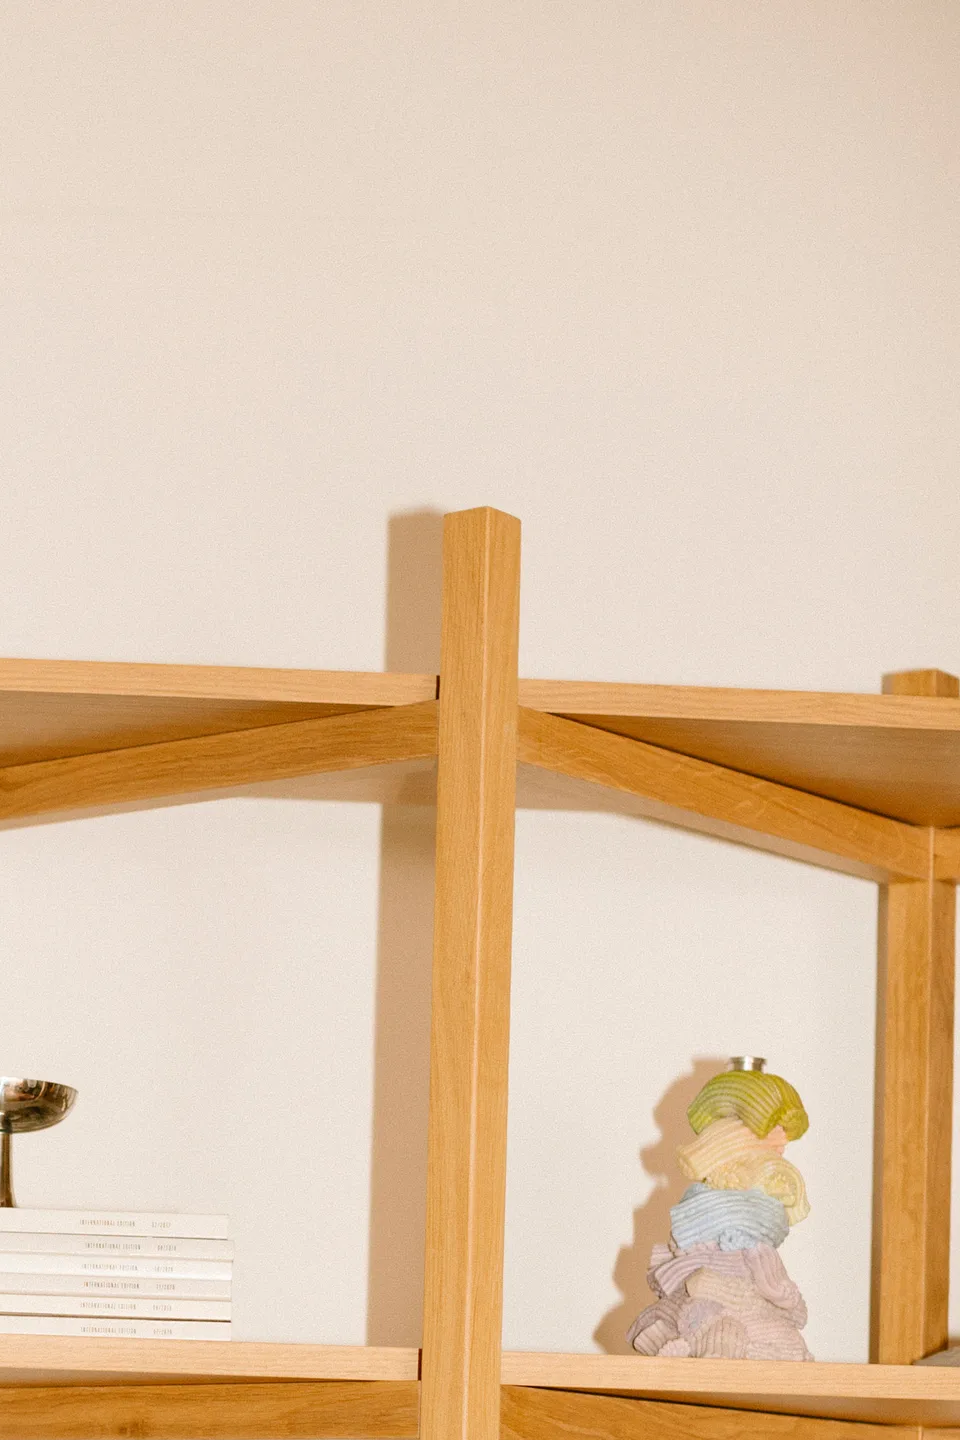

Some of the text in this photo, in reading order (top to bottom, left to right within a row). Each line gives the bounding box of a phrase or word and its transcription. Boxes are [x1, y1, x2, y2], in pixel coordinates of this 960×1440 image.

[79, 1219, 115, 1227] INTERNATIONAL
[116, 1220, 136, 1228] EDITION
[85, 1242, 121, 1250] INTERNATIONAL
[81, 1263, 118, 1271] INTERNATIONAL
[119, 1264, 138, 1272] EDITION
[83, 1281, 119, 1289] INTERNATIONAL
[120, 1282, 140, 1290] EDITION
[80, 1302, 116, 1310] INTERNATIONAL
[117, 1303, 136, 1311] EDITION
[80, 1326, 117, 1334] INTERNATIONAL
[118, 1327, 137, 1335] EDITION
